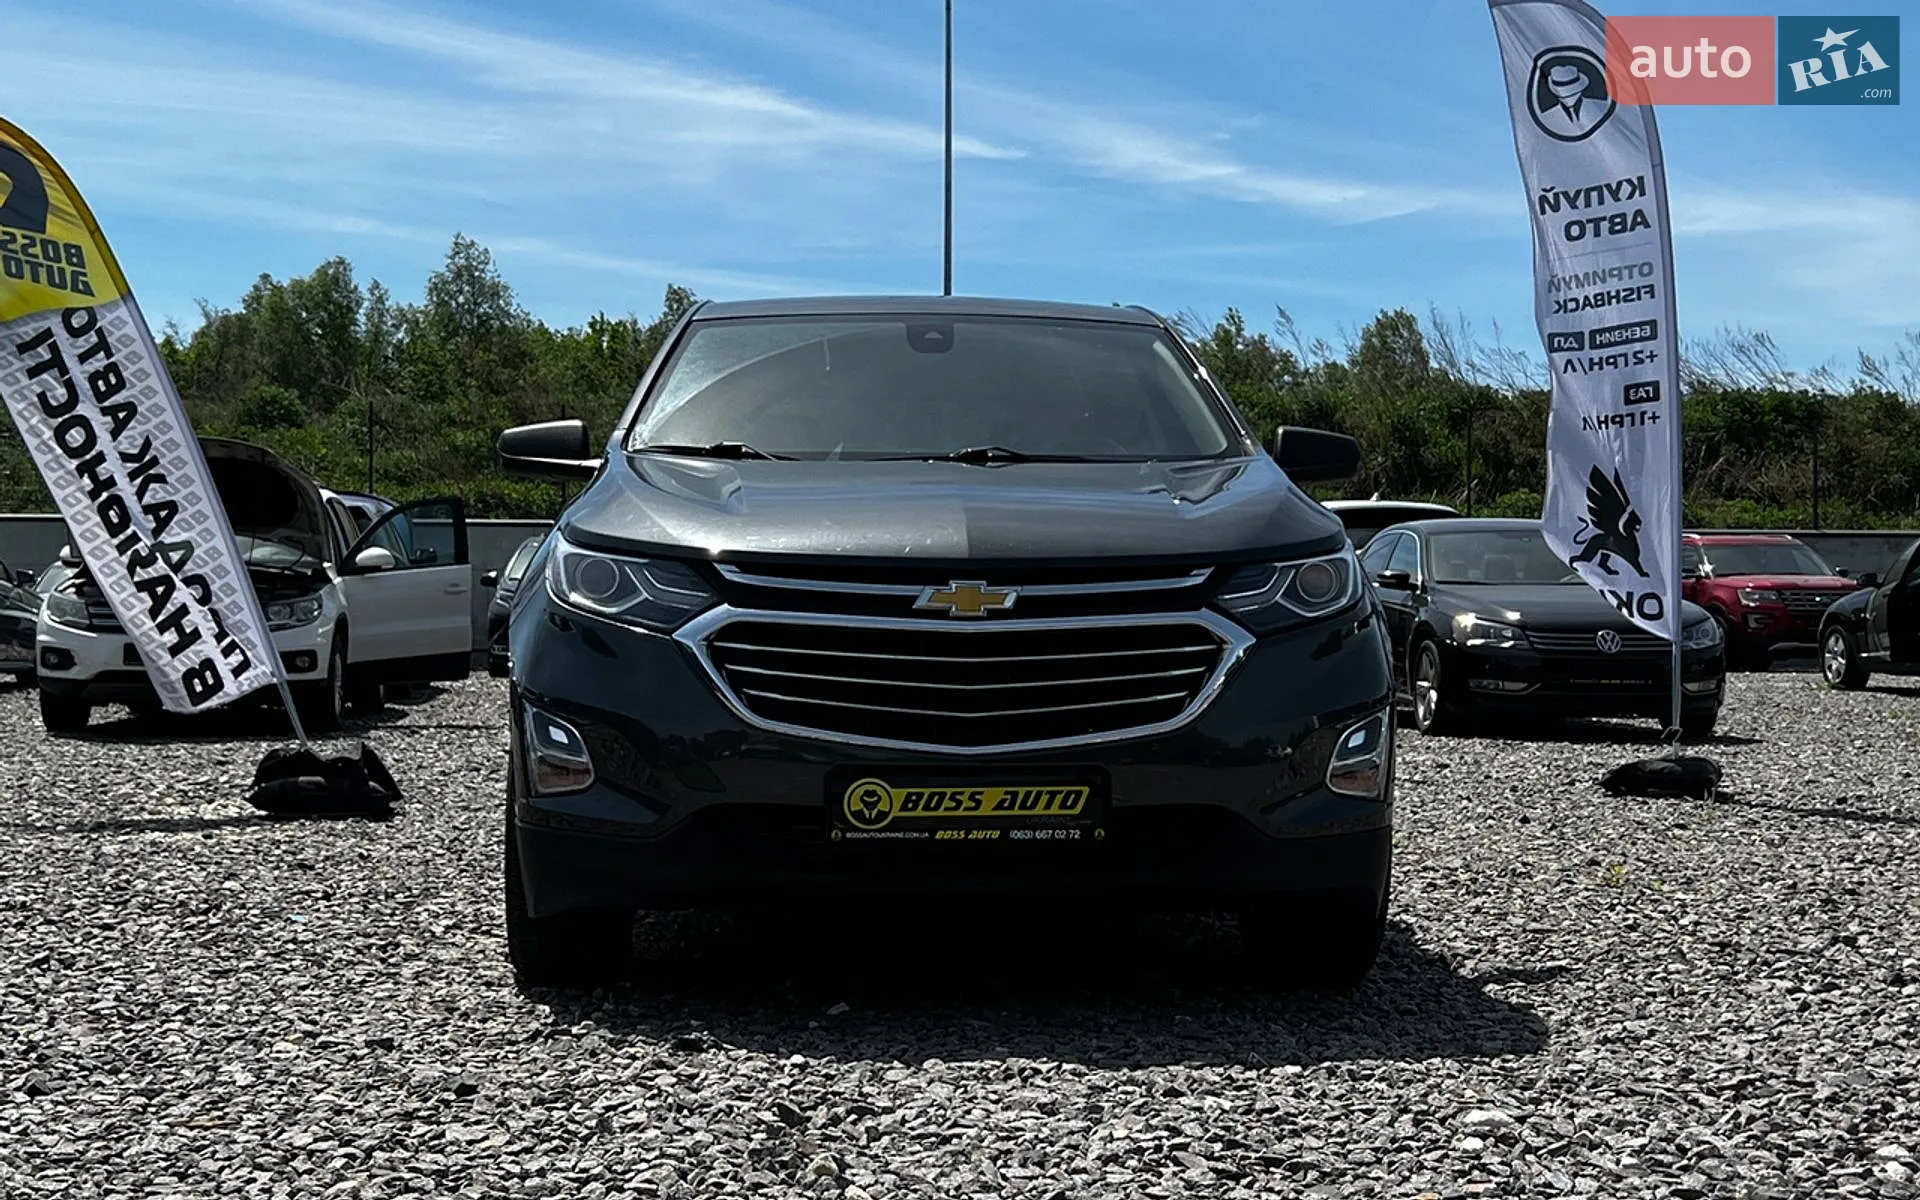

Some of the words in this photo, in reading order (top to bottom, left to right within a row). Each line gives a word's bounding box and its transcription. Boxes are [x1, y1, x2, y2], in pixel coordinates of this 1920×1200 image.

[898, 790, 986, 812] BOSS
[992, 789, 1085, 812] AUTO
[935, 830, 966, 840] BOSS
[967, 829, 1001, 839] AUTO
[1009, 829, 1034, 840] (063)
[1054, 829, 1067, 840] 02
[1068, 829, 1081, 840] 72
